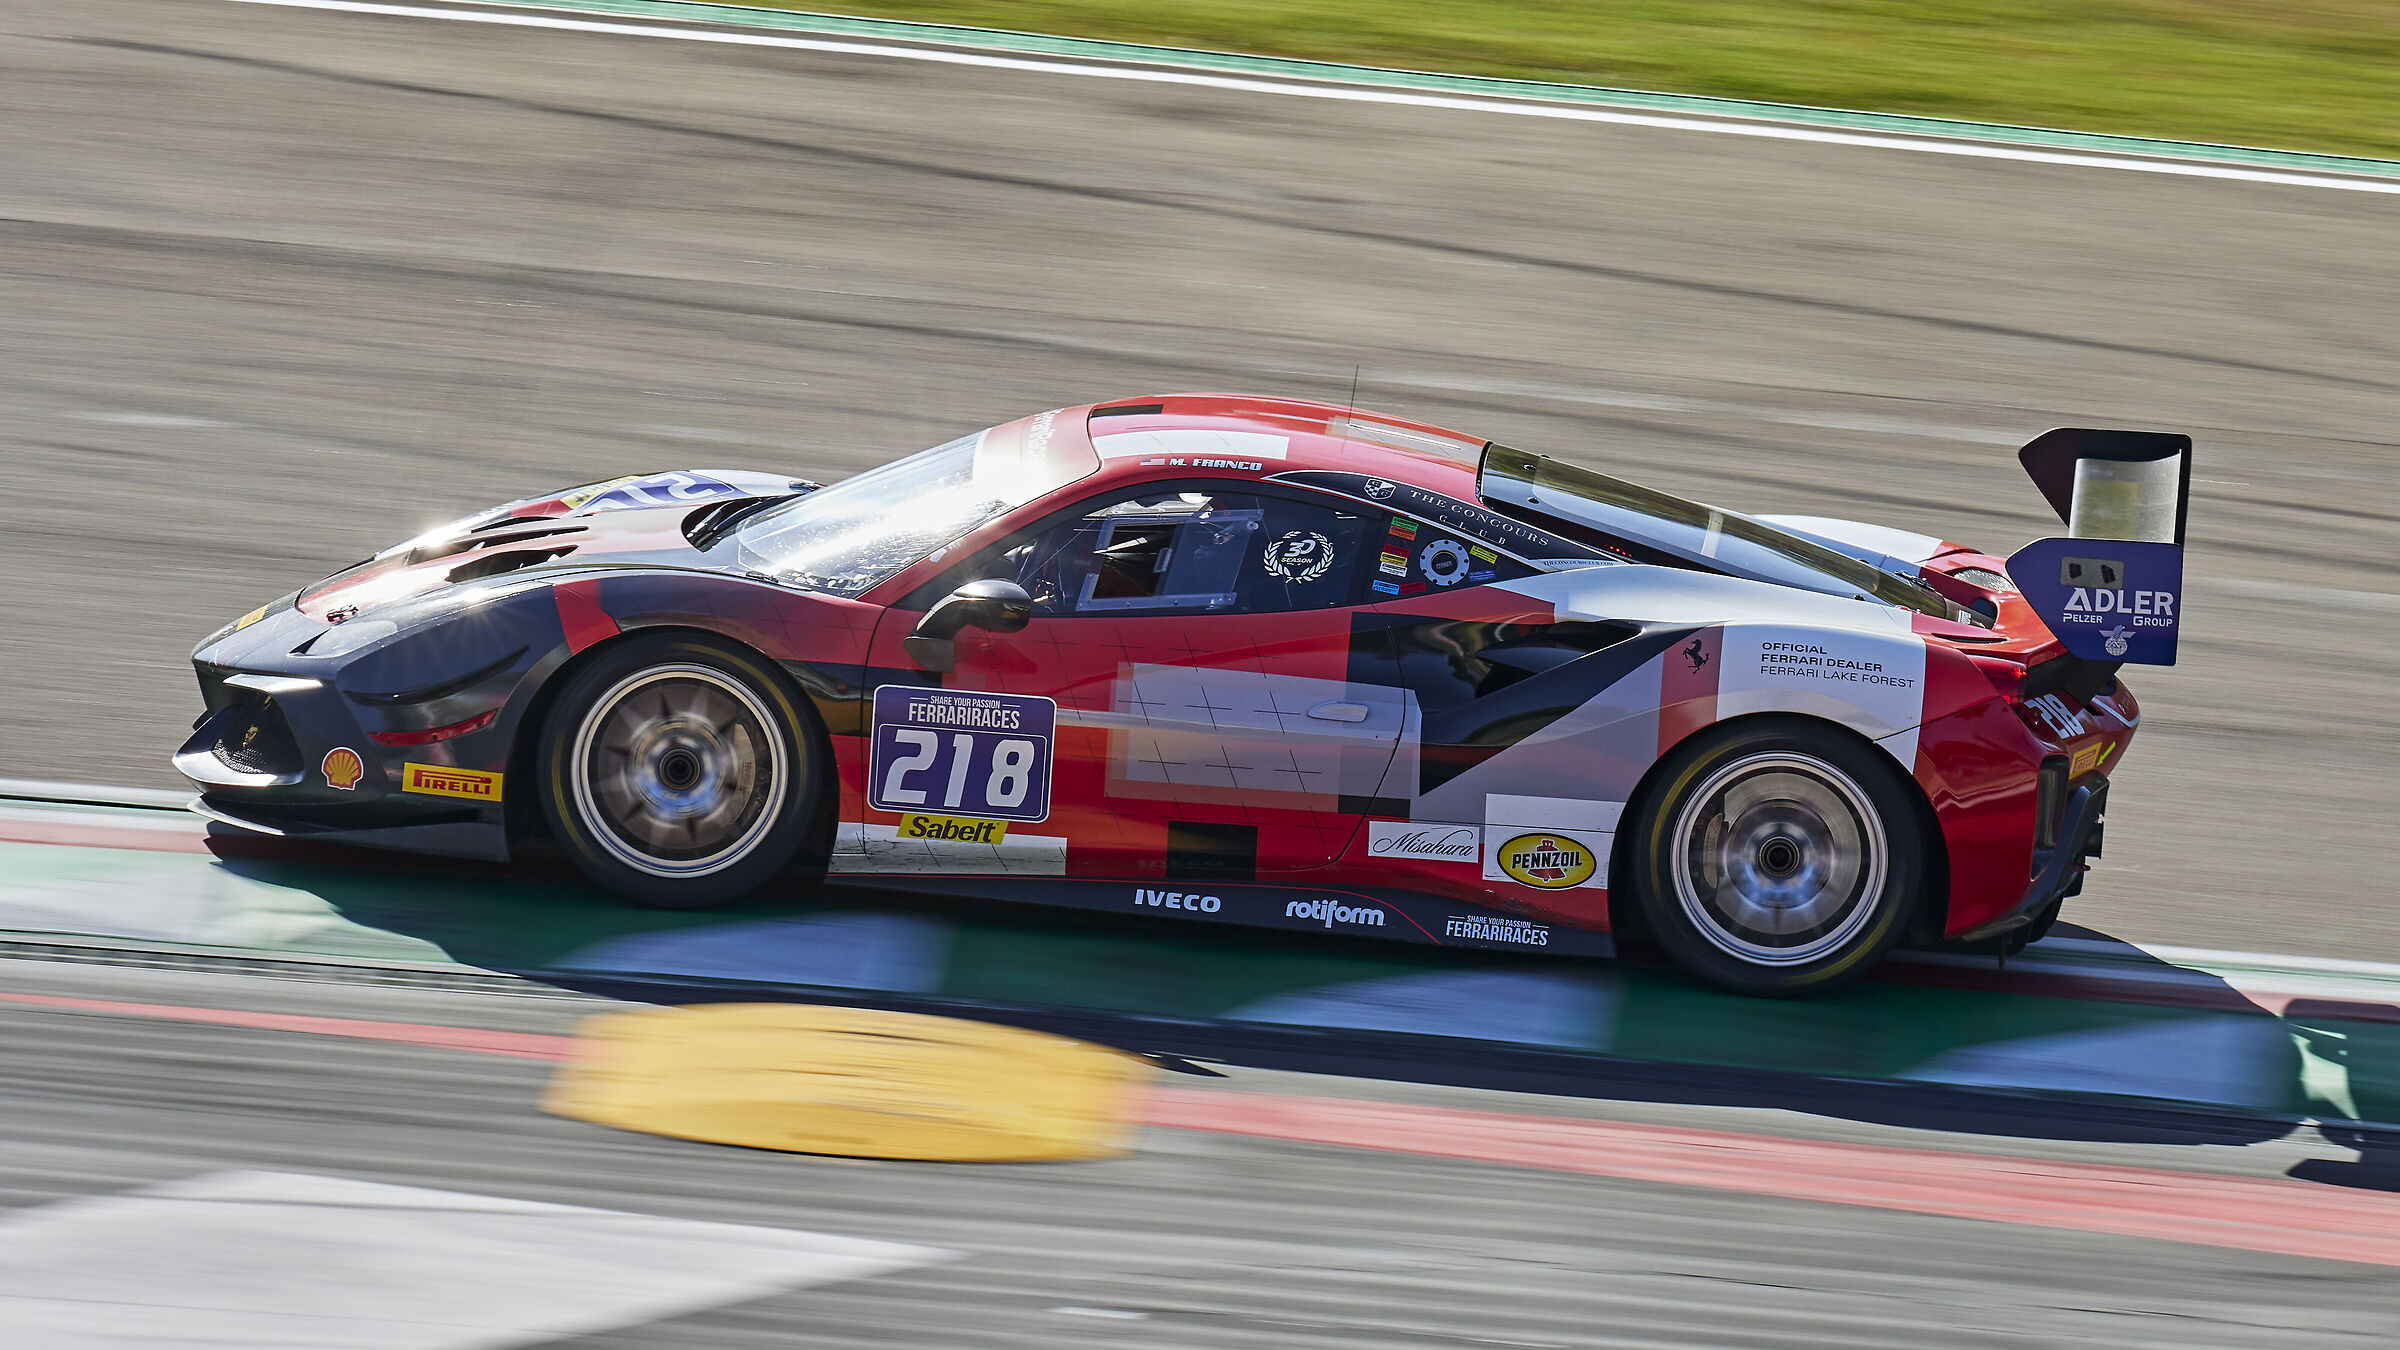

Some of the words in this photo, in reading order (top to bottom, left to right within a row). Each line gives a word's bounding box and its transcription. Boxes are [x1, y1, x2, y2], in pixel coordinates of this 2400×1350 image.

[1169, 458, 1187, 466] M.
[1192, 458, 1263, 471] FRANCO
[1410, 489, 1447, 509] THE
[1451, 504, 1549, 546] CONCOURS
[1284, 539, 1316, 557] 30
[2064, 587, 2174, 616] ADLER
[1762, 642, 1827, 654] OFFICIAL
[1761, 653, 1823, 666] FERRARI
[1826, 658, 1883, 673] DEALER
[1761, 665, 1819, 678] FERRARI
[1823, 670, 1858, 682] LAKE
[1862, 674, 1915, 688] FOREST
[930, 695, 952, 707] SHARE
[953, 697, 971, 707] YOUR
[972, 700, 1000, 709] PASSION
[908, 702, 1020, 730] FERRARIRACES
[2024, 693, 2086, 739] 218
[881, 729, 1035, 808] 218
[413, 769, 492, 795] PIRELLI
[909, 816, 996, 843] Sabelt
[1512, 851, 1583, 869] PENNZOIL
[1135, 889, 1221, 913] IVECO
[1286, 899, 1385, 928] rotiform
[1446, 920, 1549, 946] FERRARIRACES
[1467, 914, 1487, 924] SHARE
[1488, 917, 1504, 926] YOUR
[1505, 918, 1531, 928] PASSION
